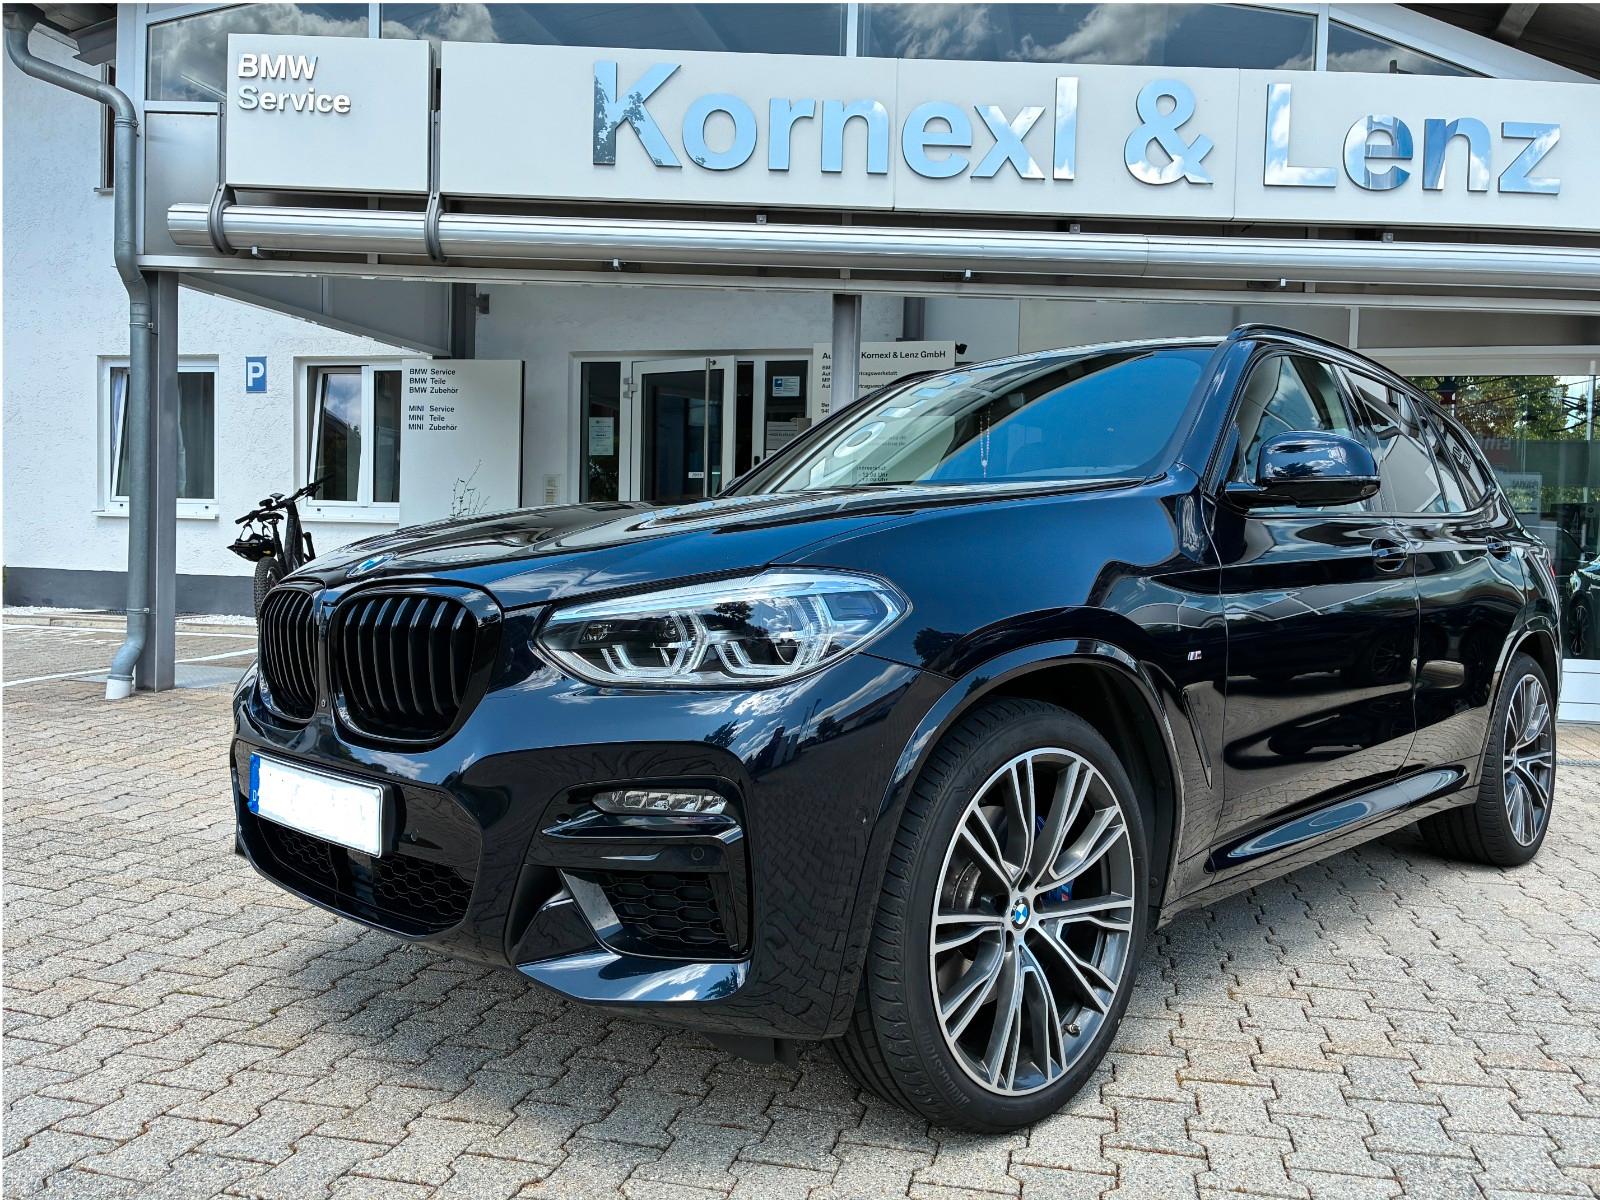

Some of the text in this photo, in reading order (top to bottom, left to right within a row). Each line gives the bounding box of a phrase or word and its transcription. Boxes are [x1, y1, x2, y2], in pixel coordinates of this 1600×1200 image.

[238, 53, 318, 80] BMW
[238, 84, 351, 114] Service
[593, 60, 1561, 195] Kornexl & Lenz
[861, 351, 891, 360] Kornexl
[892, 351, 898, 360] &
[900, 350, 919, 360] Lenz
[920, 350, 946, 359] GmbH
[247, 361, 265, 387] P
[409, 368, 456, 376] BMW Service
[409, 377, 447, 385] BMW Teile
[430, 386, 459, 395] Zubehör
[408, 405, 455, 413] MINI Service
[408, 414, 446, 422] MINI Teile
[408, 423, 458, 432] MINI Zubehör
